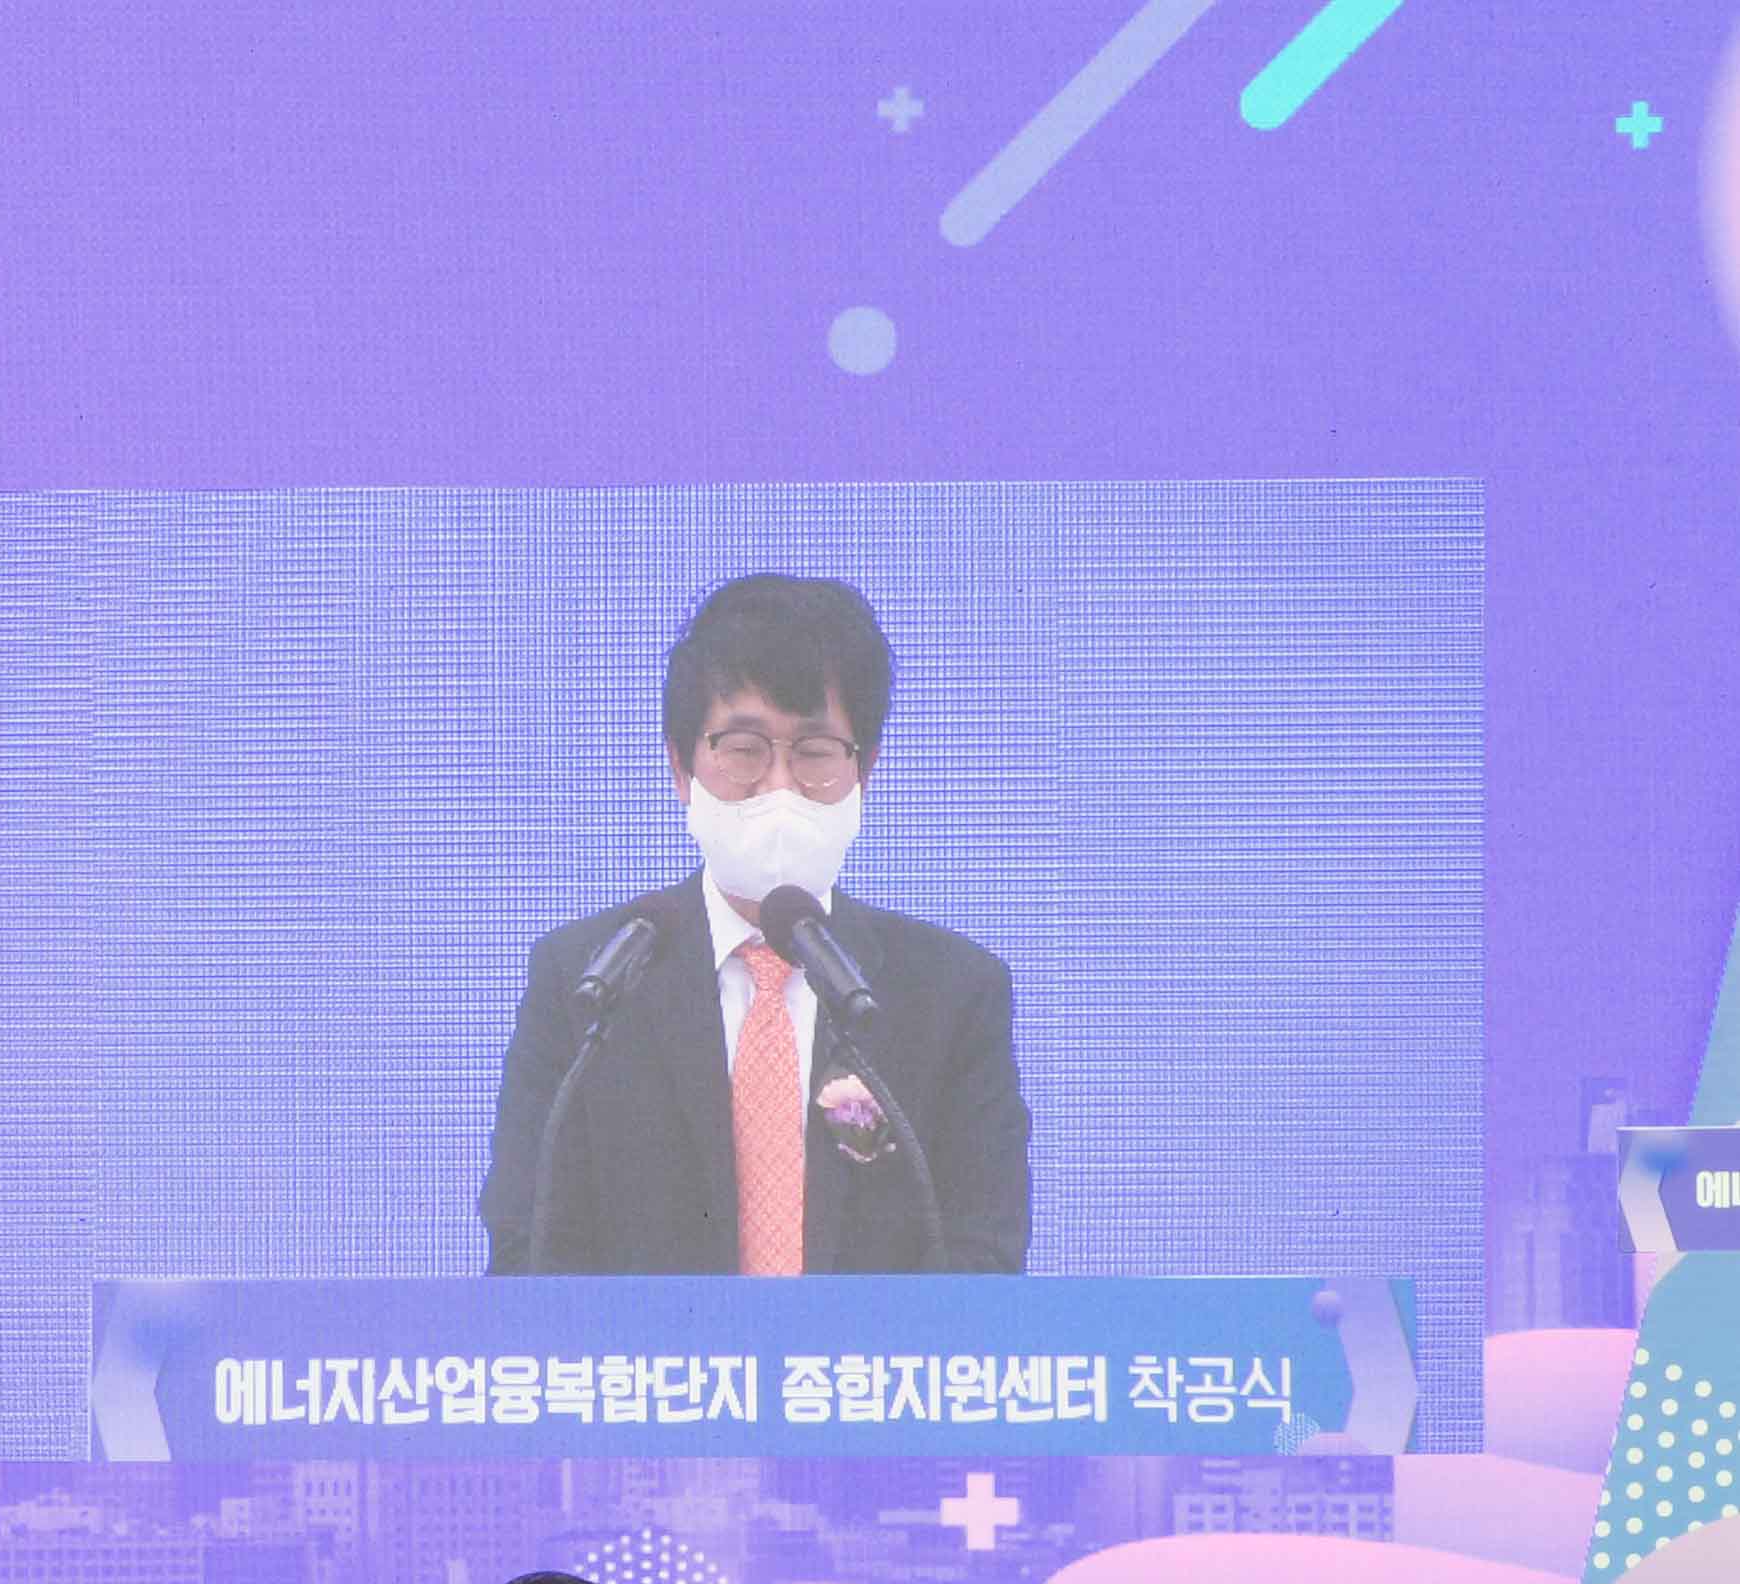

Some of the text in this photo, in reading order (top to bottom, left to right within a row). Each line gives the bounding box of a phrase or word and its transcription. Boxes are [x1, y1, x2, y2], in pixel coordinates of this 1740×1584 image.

[1695, 1171, 1740, 1209] 에
[215, 1355, 1292, 1425] 에너지산업융복합단지 종합지원센터 착공식
